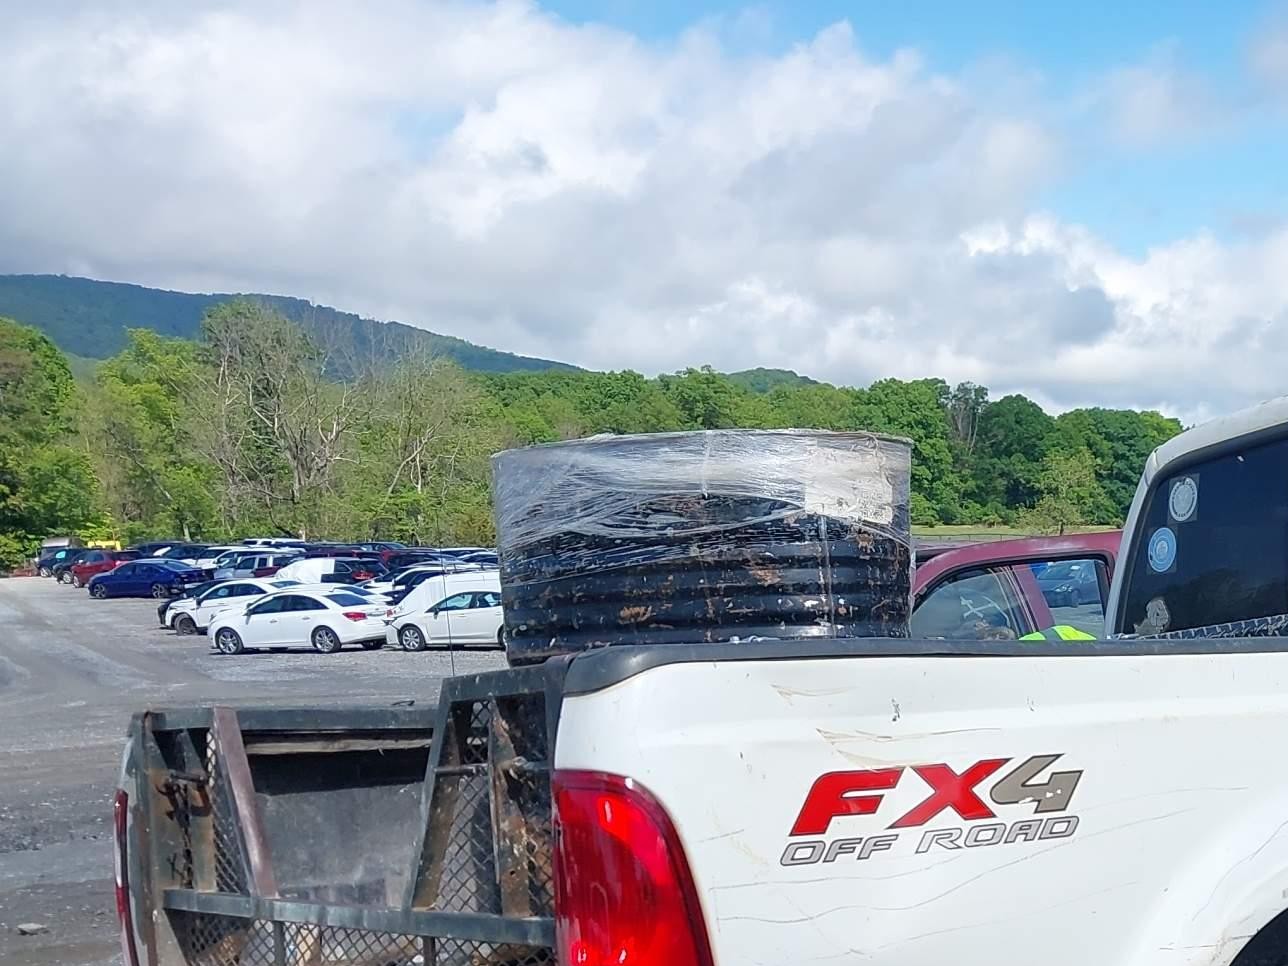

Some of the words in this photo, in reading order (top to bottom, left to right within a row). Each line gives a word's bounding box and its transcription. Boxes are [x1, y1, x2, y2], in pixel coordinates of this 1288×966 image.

[789, 753, 1084, 837] FX4
[780, 834, 899, 867] OFF
[915, 815, 1080, 854] ROAD
